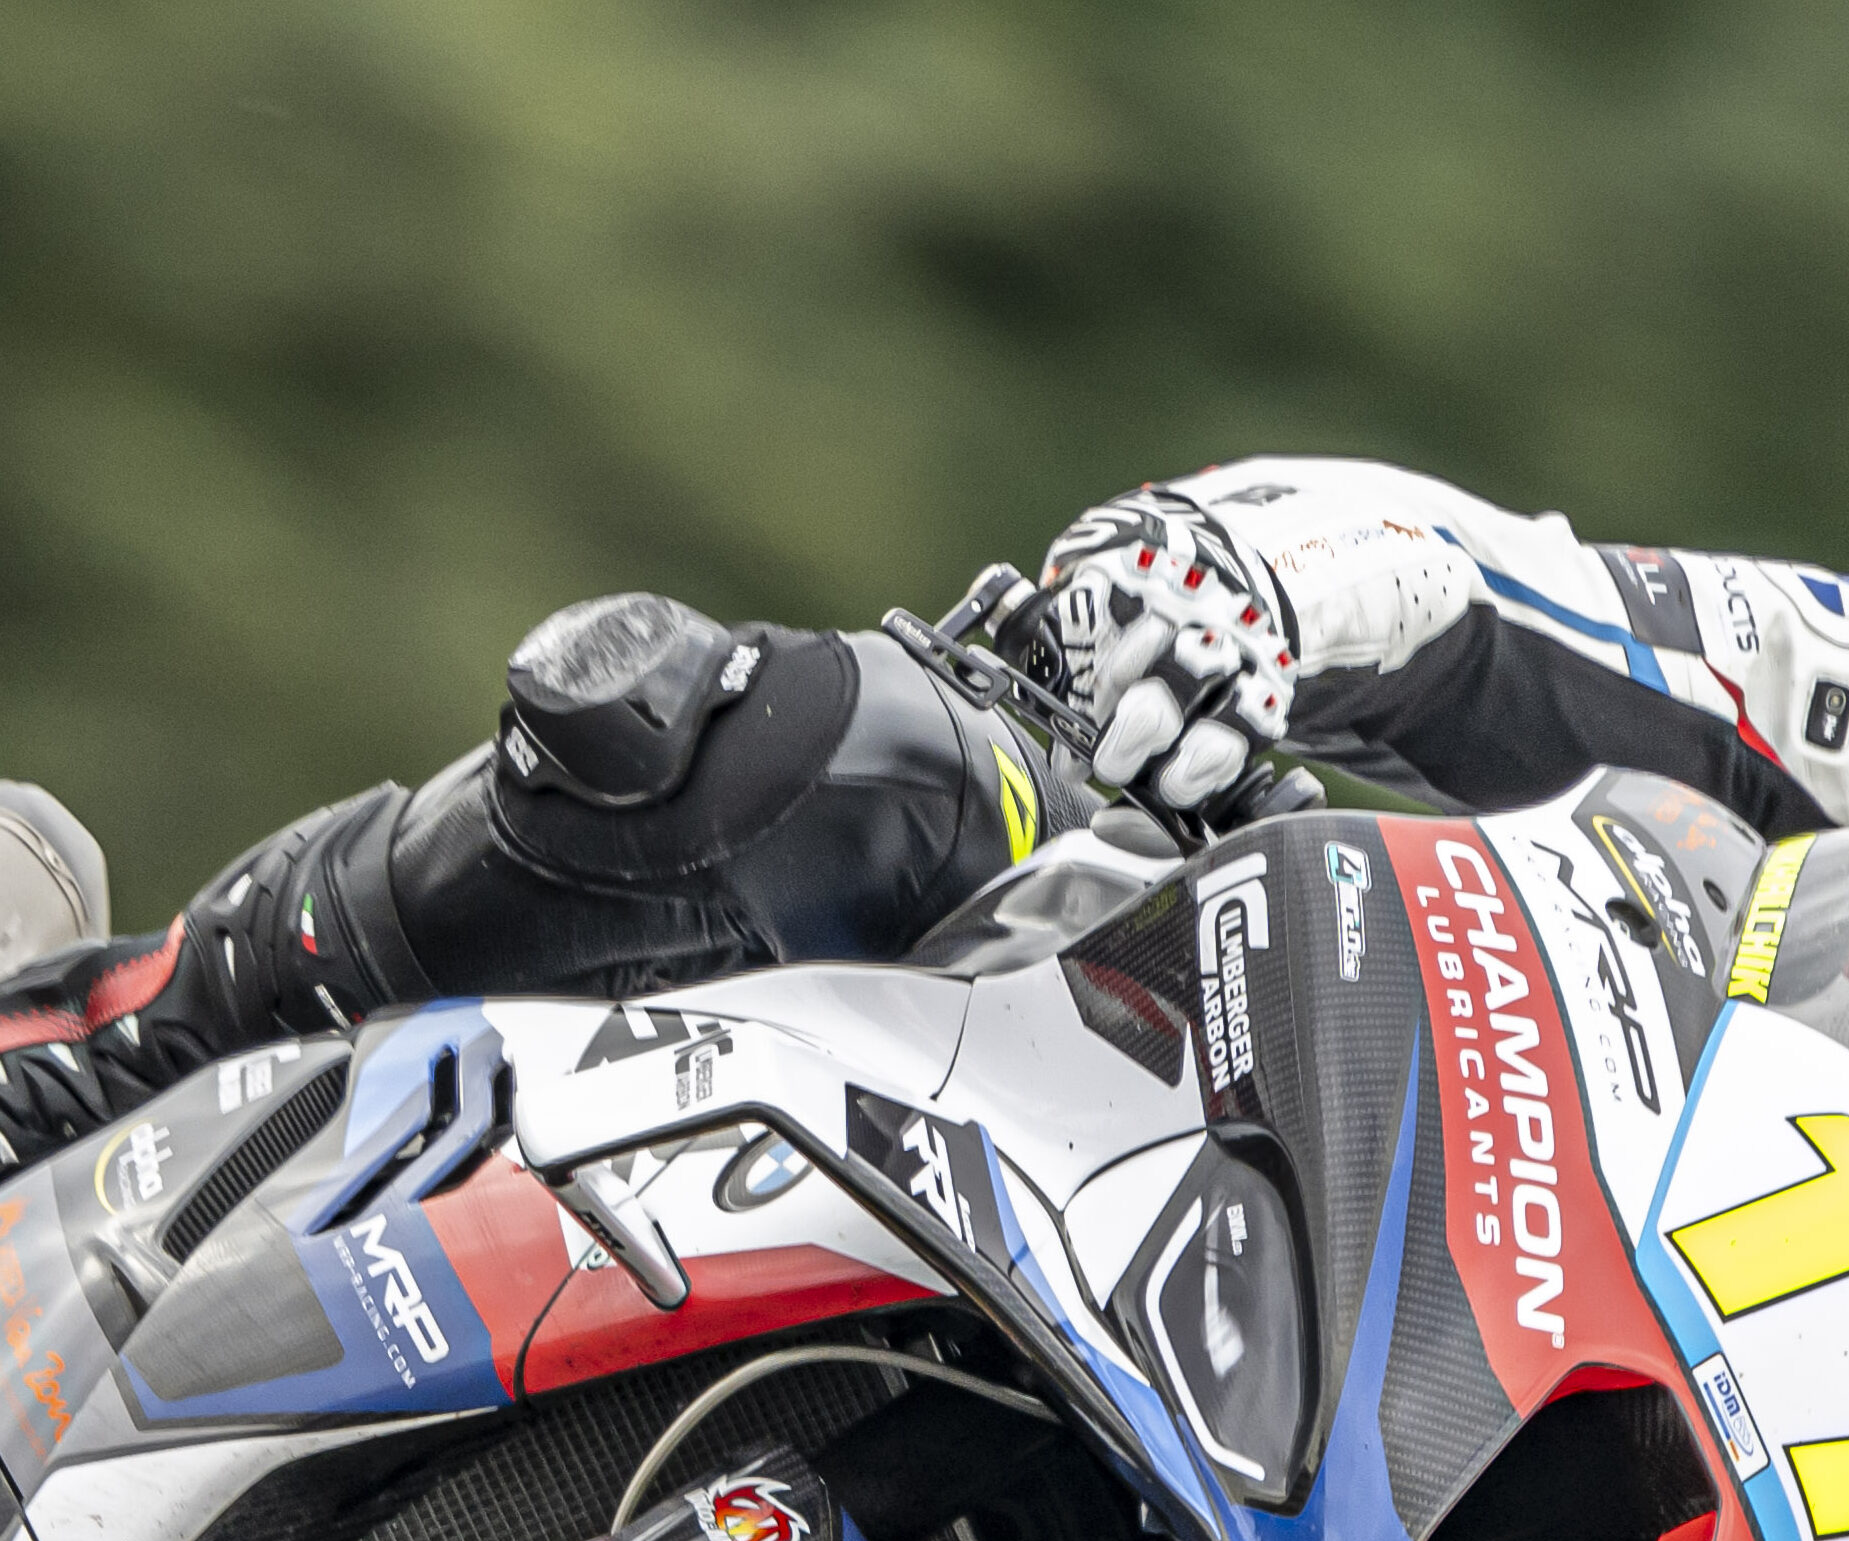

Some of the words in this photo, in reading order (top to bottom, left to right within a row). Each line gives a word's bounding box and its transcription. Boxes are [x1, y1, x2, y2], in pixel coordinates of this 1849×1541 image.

[1219, 906, 1254, 1082] ILMBERGER
[1416, 886, 1501, 1247] LUBRICANTS
[1435, 838, 1565, 1336] CHAMPION
[350, 1213, 450, 1364] MRP
